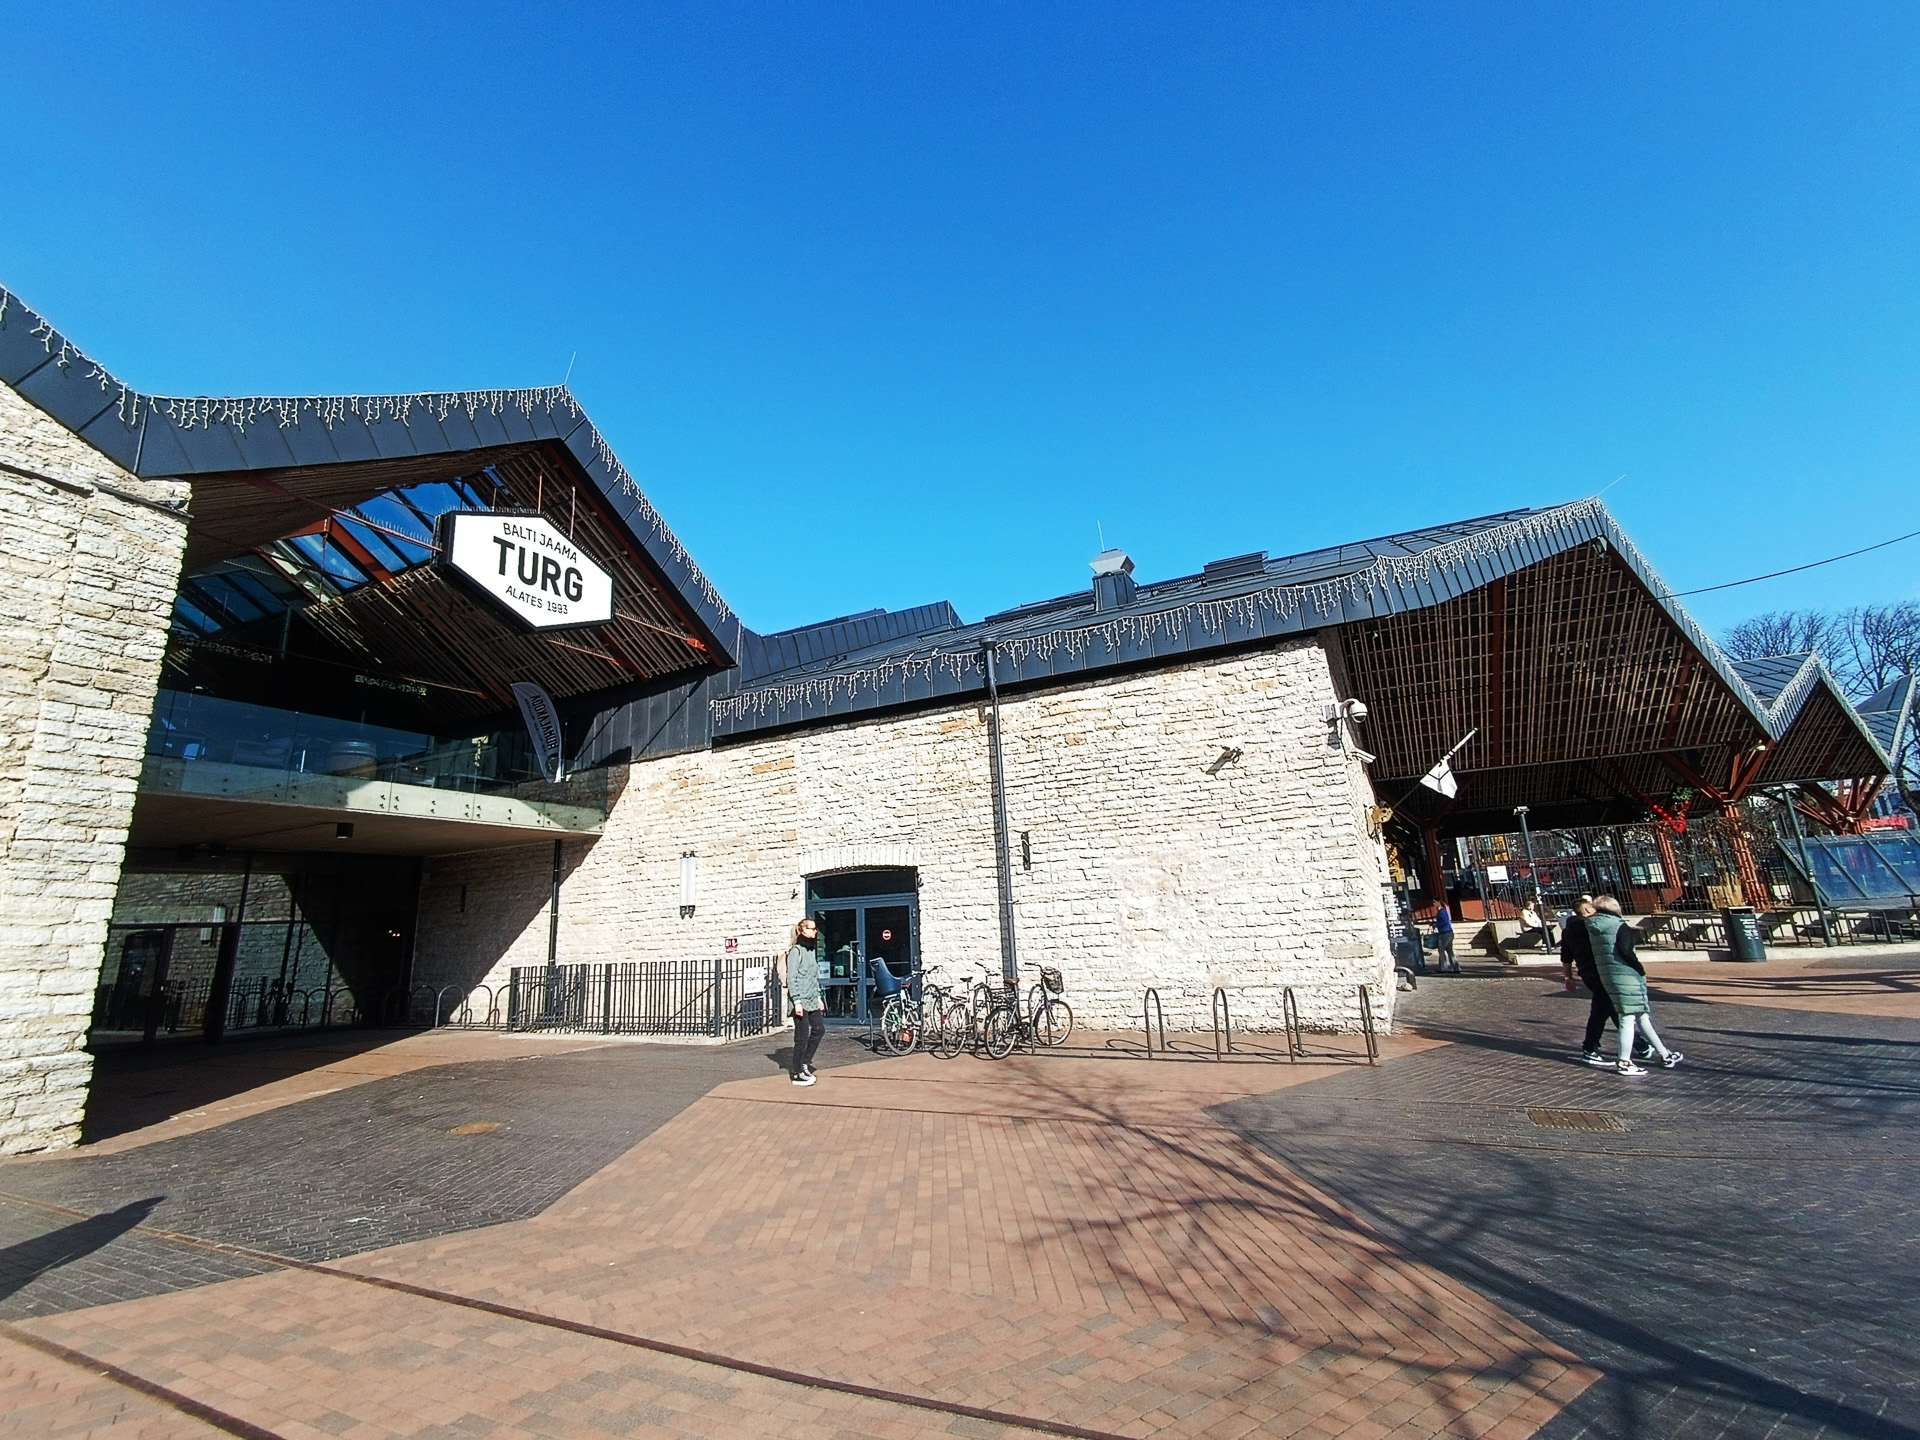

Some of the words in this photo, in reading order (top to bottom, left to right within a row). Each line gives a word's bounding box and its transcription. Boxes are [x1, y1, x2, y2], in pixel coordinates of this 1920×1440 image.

[503, 522, 537, 542] BALTI
[539, 533, 578, 563] JAAMA
[493, 535, 583, 603] TURG
[505, 585, 543, 609] ALATES
[547, 600, 568, 615] 1993
